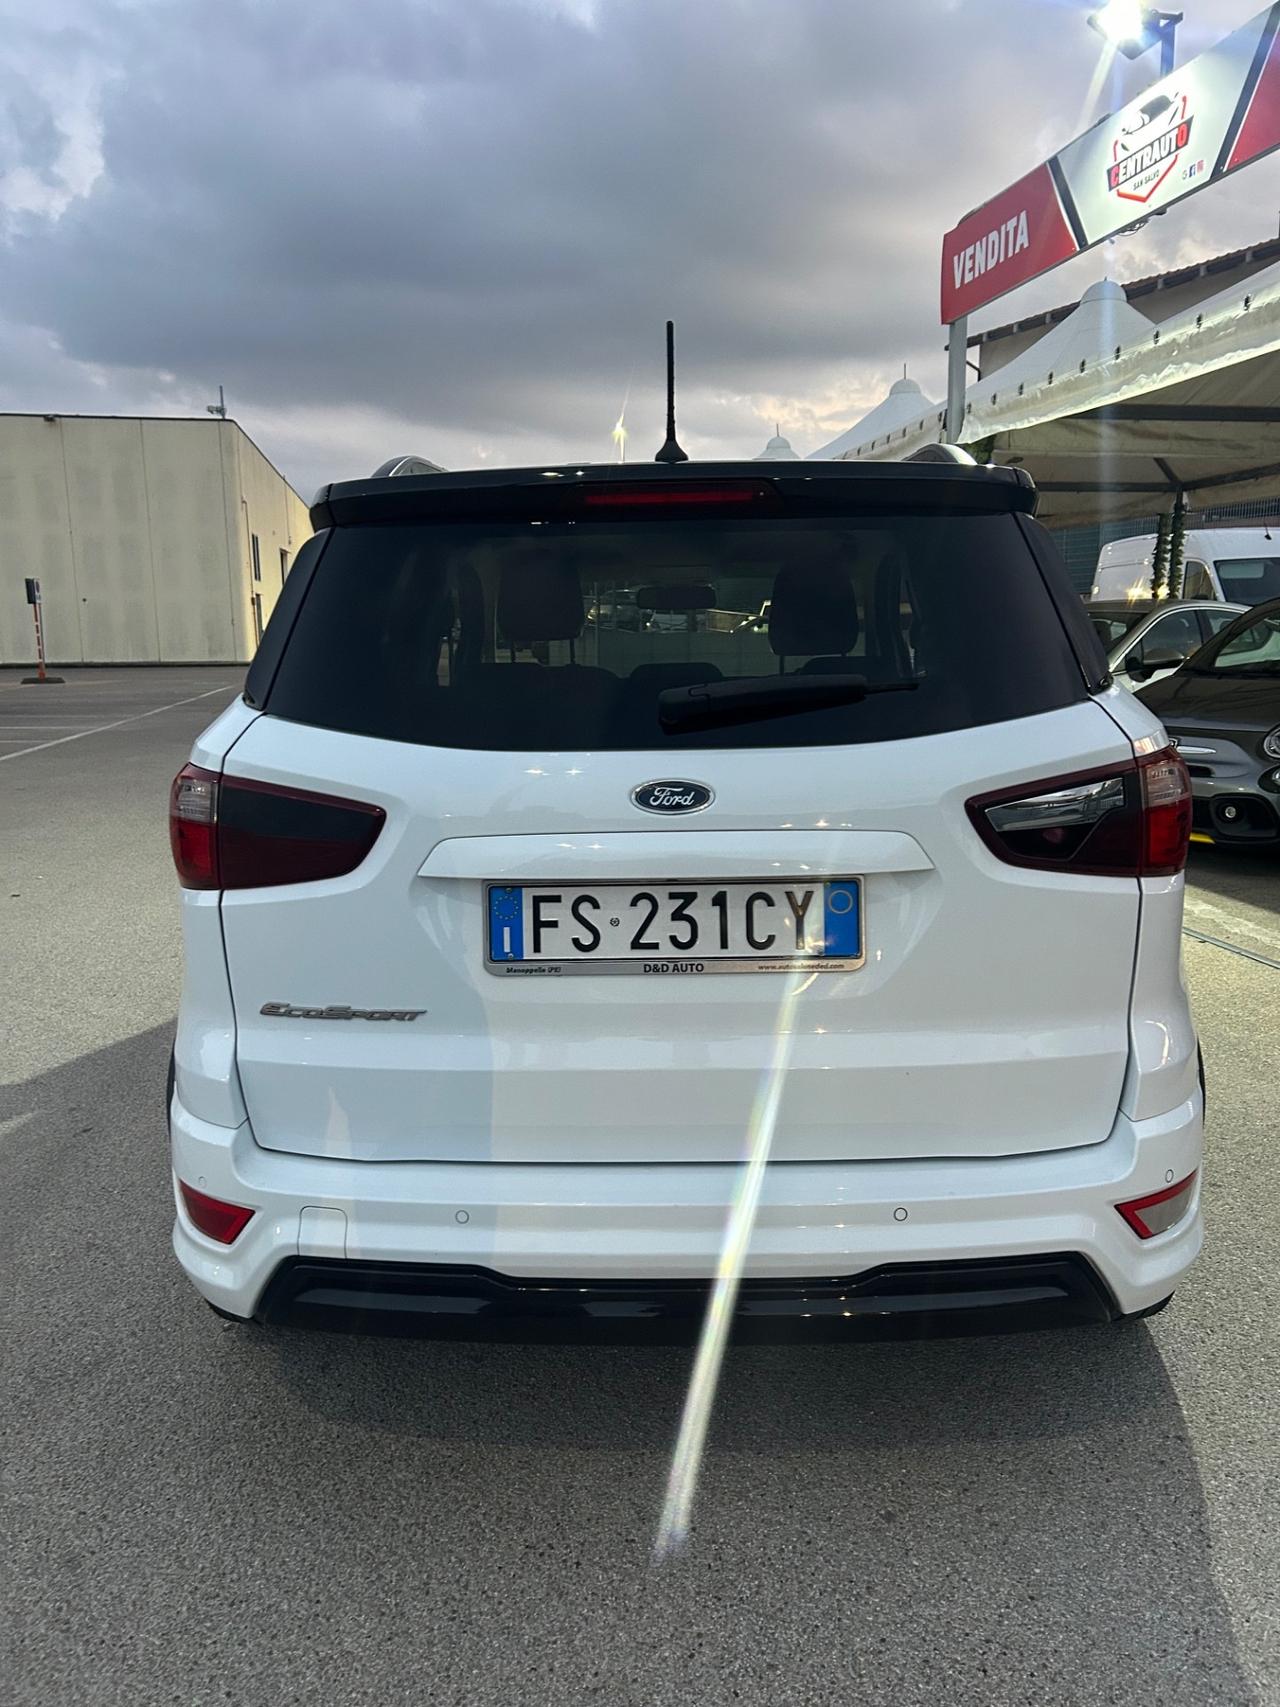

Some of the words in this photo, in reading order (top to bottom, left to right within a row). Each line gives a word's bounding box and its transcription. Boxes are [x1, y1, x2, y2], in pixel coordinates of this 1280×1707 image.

[1110, 122, 1188, 187] CENTRAUTO
[953, 210, 1031, 290] VENDITA
[649, 786, 695, 806] Ford
[532, 894, 601, 953] FS
[630, 890, 814, 951] 231CY
[643, 963, 669, 973] D&D
[671, 962, 704, 973] AUTO
